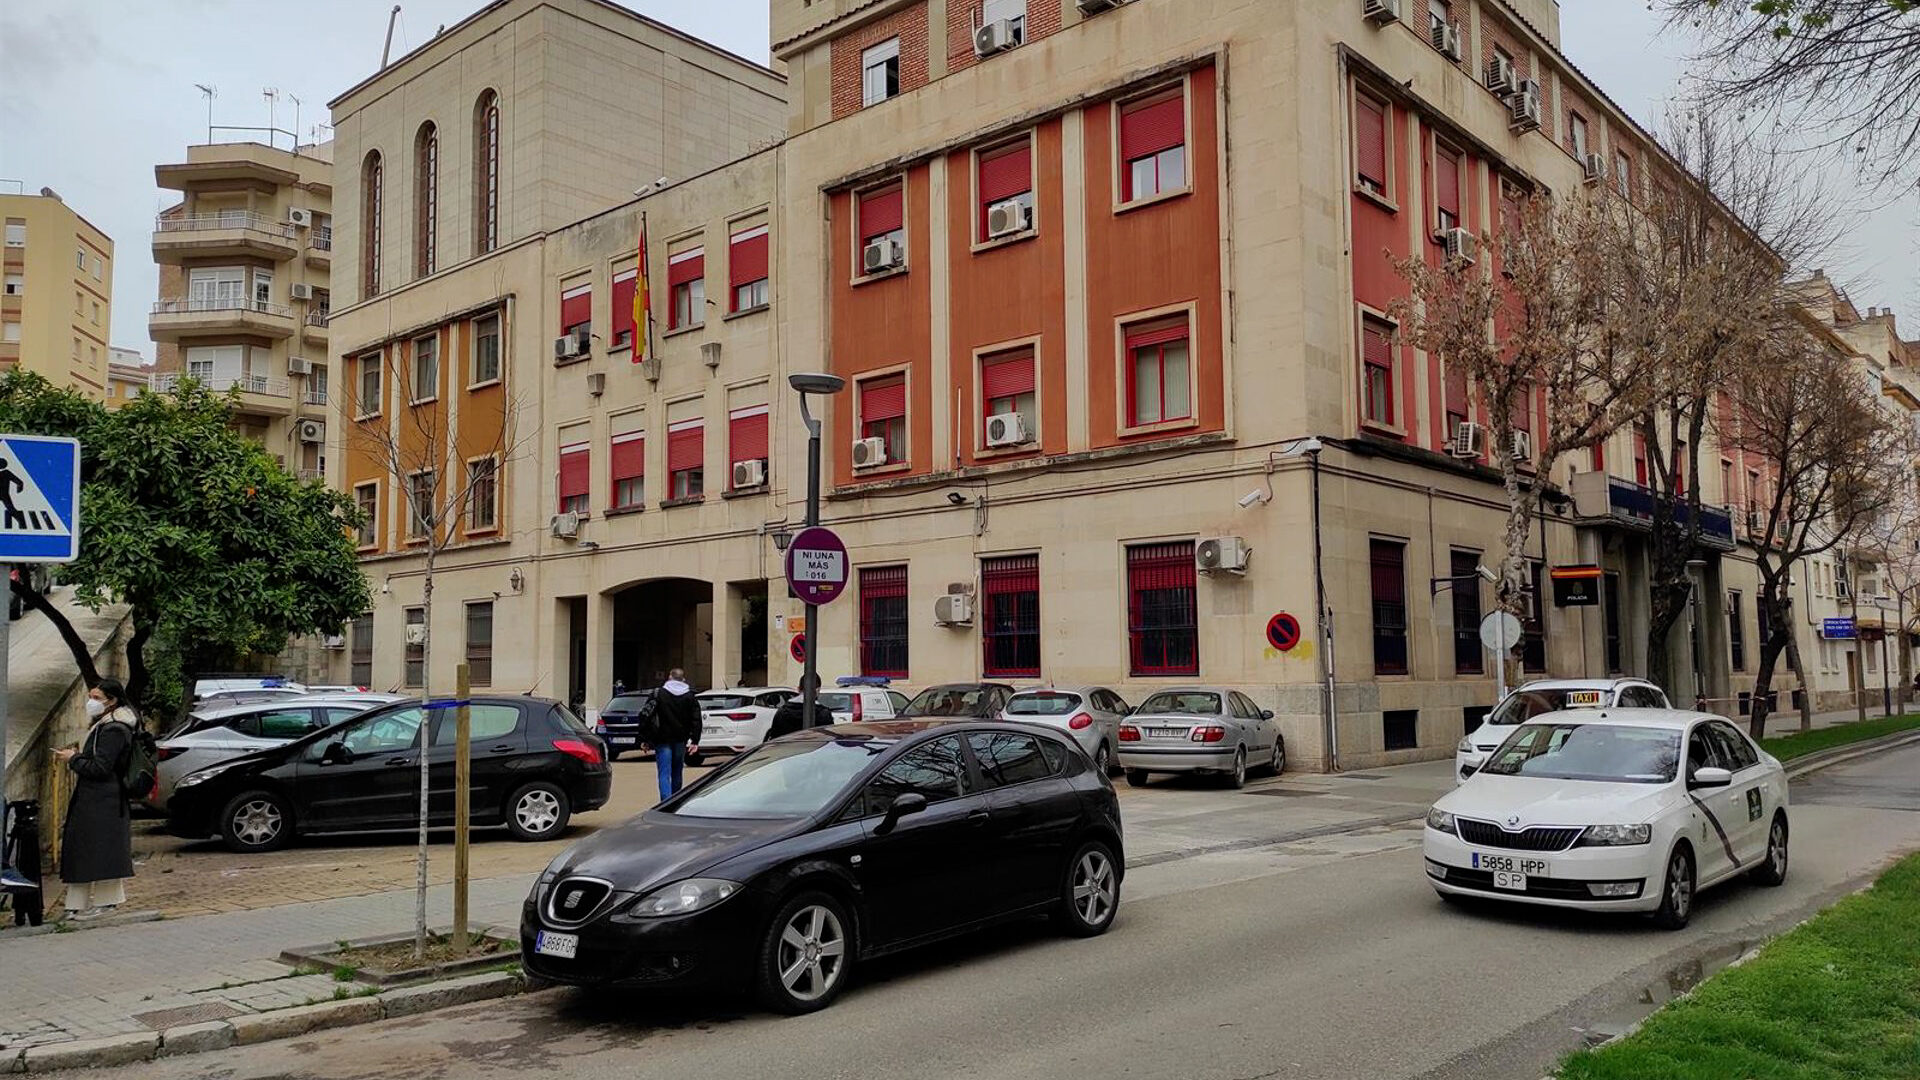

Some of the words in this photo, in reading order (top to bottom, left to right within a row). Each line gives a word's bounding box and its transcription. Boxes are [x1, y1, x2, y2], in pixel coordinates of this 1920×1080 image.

[802, 551, 812, 559] NI
[814, 552, 835, 560] UNA
[810, 572, 827, 580] 016
[1575, 693, 1592, 703] TAXI
[1482, 855, 1513, 871] 5858
[1520, 859, 1546, 874] HPP
